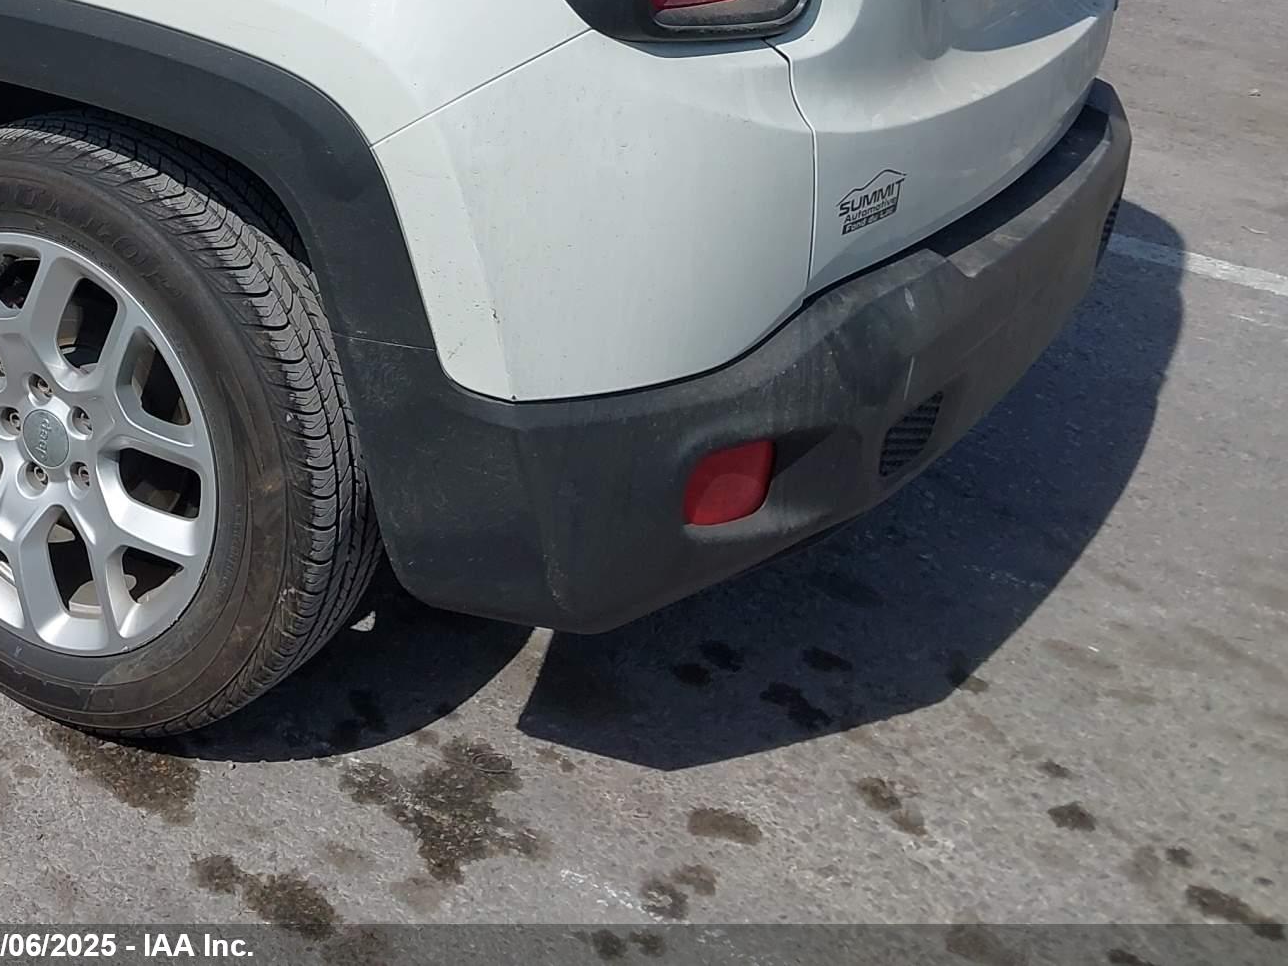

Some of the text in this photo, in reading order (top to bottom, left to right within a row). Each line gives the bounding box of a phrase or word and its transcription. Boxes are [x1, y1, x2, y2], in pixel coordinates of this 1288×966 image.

[838, 177, 906, 217] SUMMIT
[843, 196, 897, 224] Automotive
[34, 417, 53, 459] Jeep
